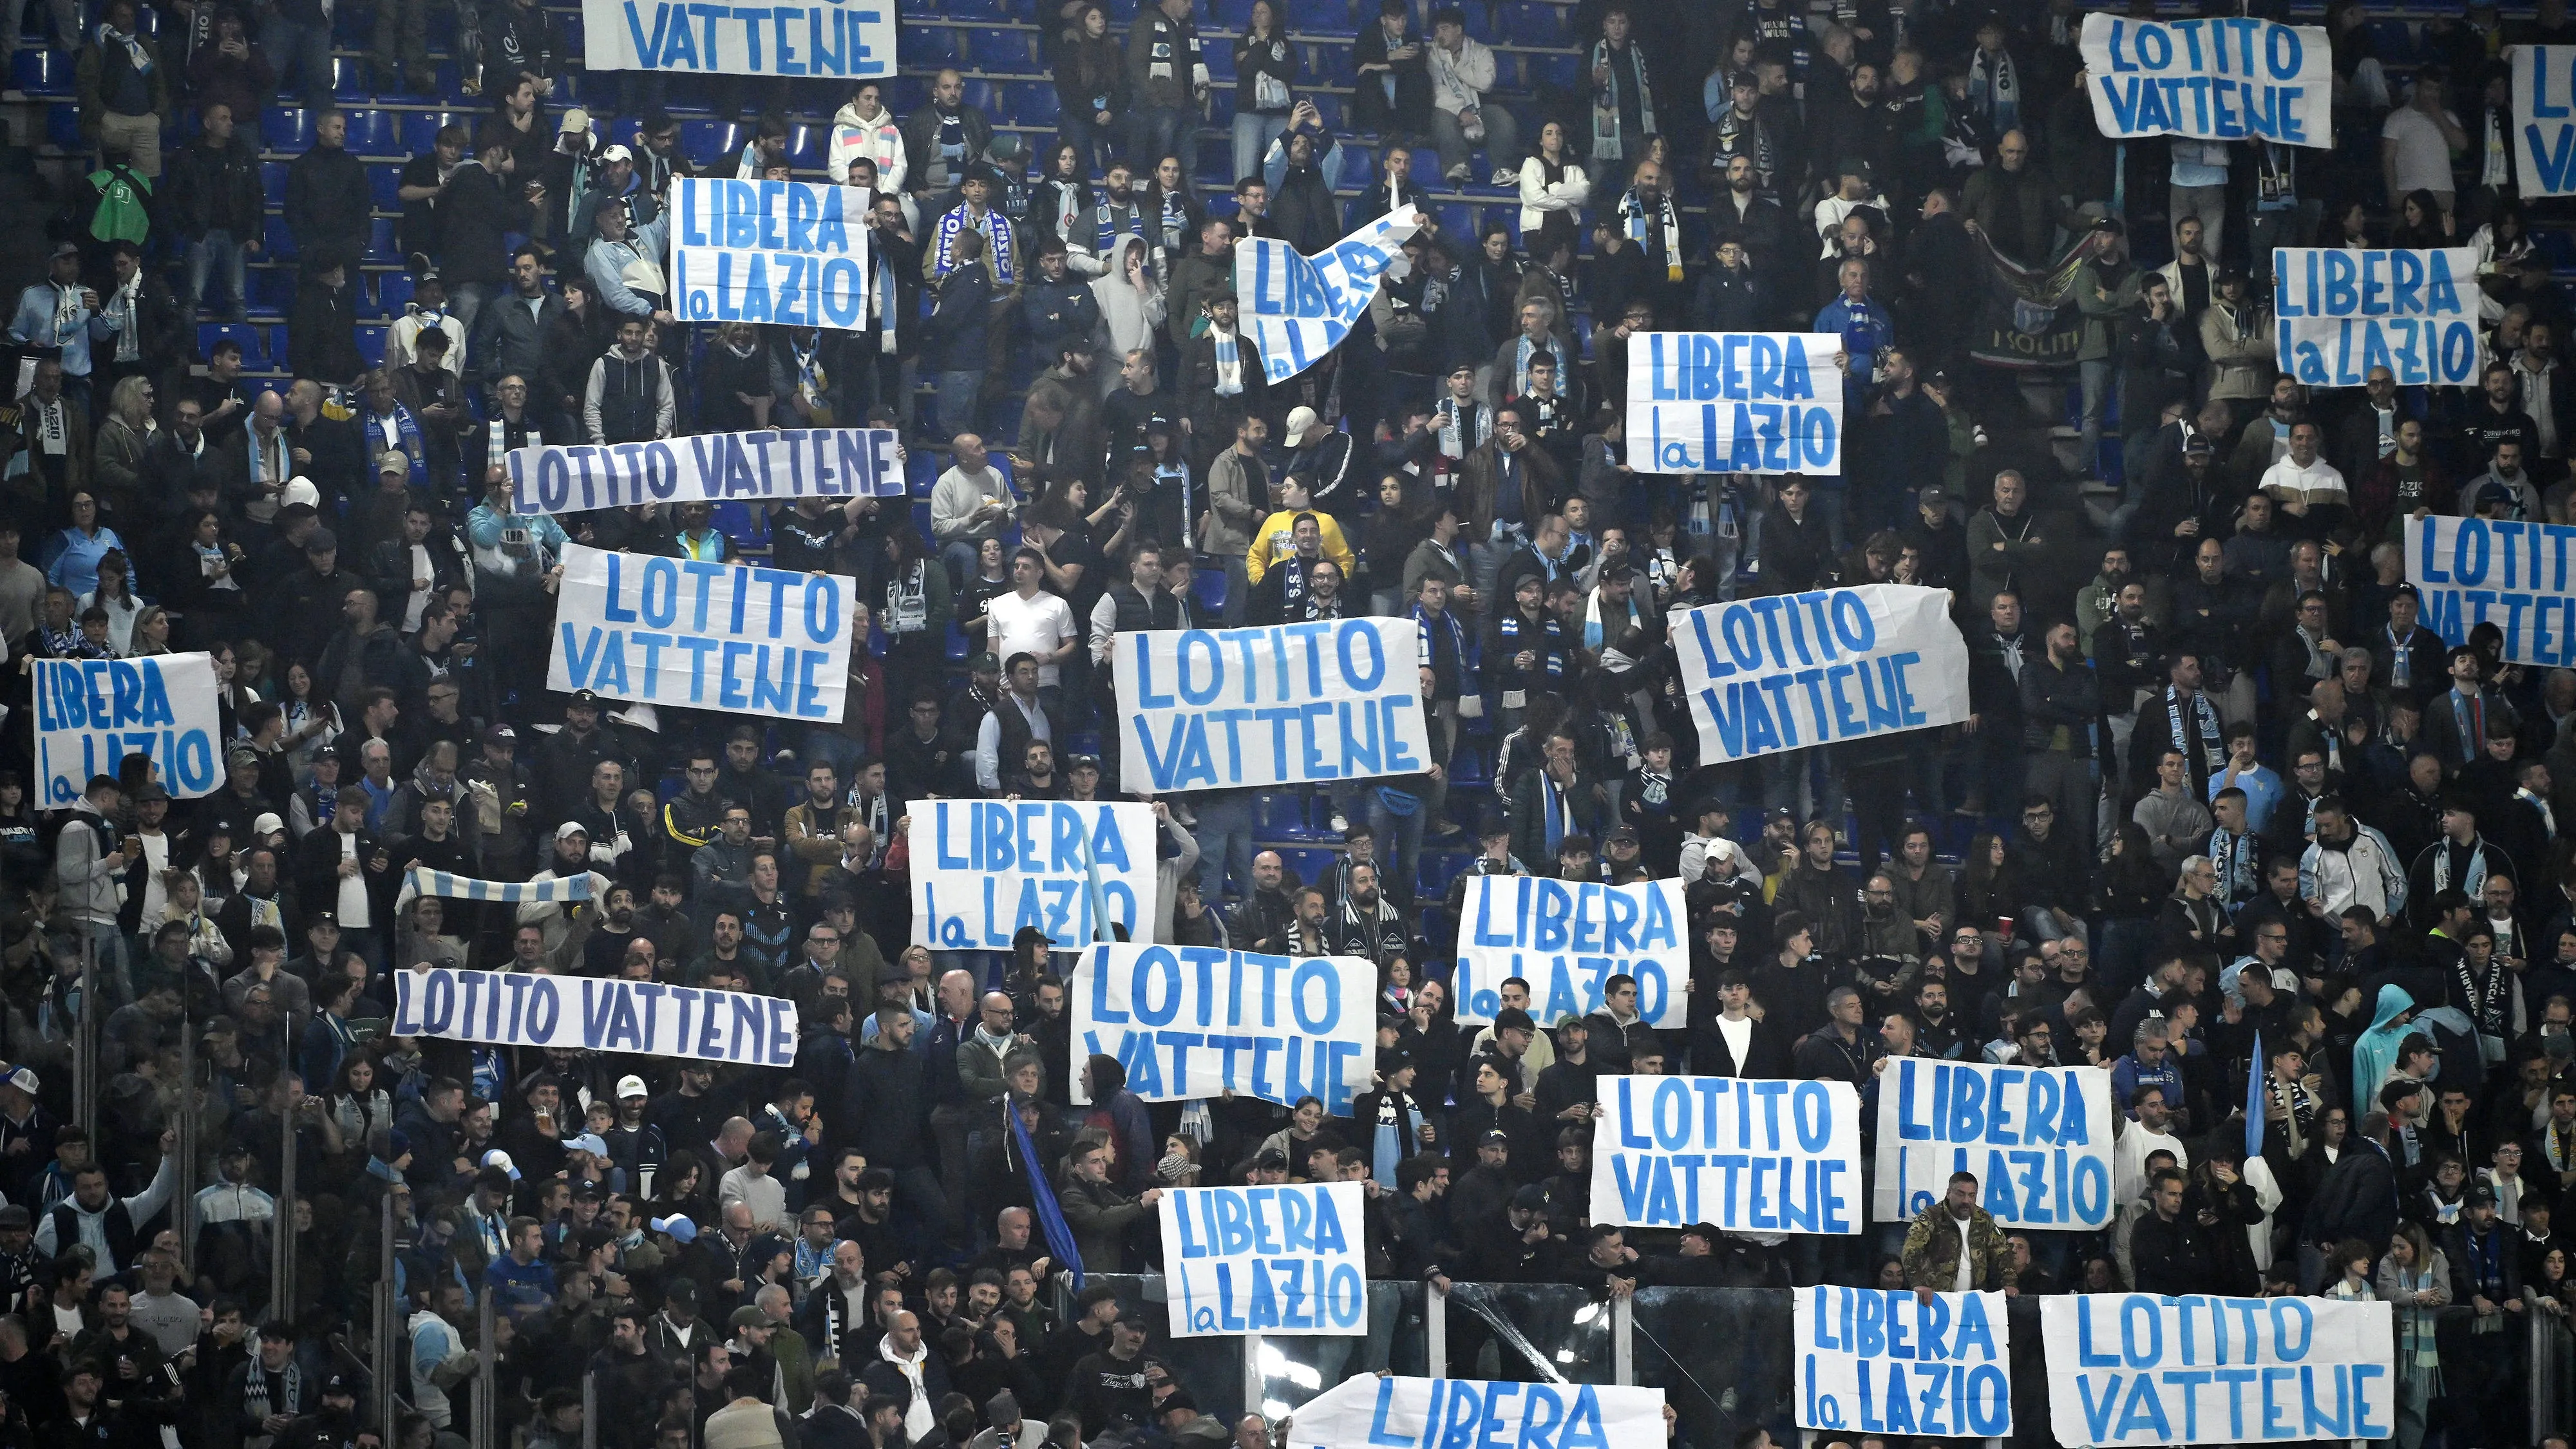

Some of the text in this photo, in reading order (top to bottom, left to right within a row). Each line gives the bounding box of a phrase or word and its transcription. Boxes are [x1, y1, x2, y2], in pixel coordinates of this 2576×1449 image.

[623, 1, 884, 75] VATTENE
[2109, 17, 2302, 80] LOTITO
[2101, 76, 2306, 142] VATTENE
[683, 176, 848, 252] LIBERA
[717, 252, 861, 325] LAZIO
[2276, 249, 2461, 317] LIBERA
[1651, 334, 1814, 401] LIBERA
[2336, 317, 2474, 385] LAZIO
[510, 430, 902, 515] LOTITO VATTENE
[1702, 402, 1835, 471] LAZIO
[605, 553, 839, 645] LOTITO
[1690, 591, 1875, 679] LOTITO
[37, 658, 175, 732] LIBERA
[562, 622, 829, 717] VATTENE
[1136, 620, 1386, 709] LOTITO
[1701, 652, 1926, 757] VATTENE
[1133, 695, 1419, 790] VATTENE
[936, 802, 1132, 873] LIBERA
[983, 876, 1137, 947] LAZIO
[1475, 876, 1676, 954] LIBERA
[396, 970, 790, 1063] LOTITO VATTENE
[1092, 945, 1340, 1035] LOTITO
[1512, 954, 1668, 1025] LAZO
[1618, 1077, 1832, 1153] LOTITO
[1899, 1060, 2088, 1147] LIBERA
[1174, 1187, 1347, 1258] LIBERA
[1611, 1153, 1849, 1233] VATTENE
[1216, 1259, 1362, 1331] LAZIO
[1815, 1286, 1996, 1361] LIBERA
[2078, 1295, 2313, 1369] LOTITO
[1368, 1378, 1609, 1449] LIBERA
[1857, 1356, 2009, 1436] LAZIO
[2076, 1364, 2387, 1443] VATTENE
